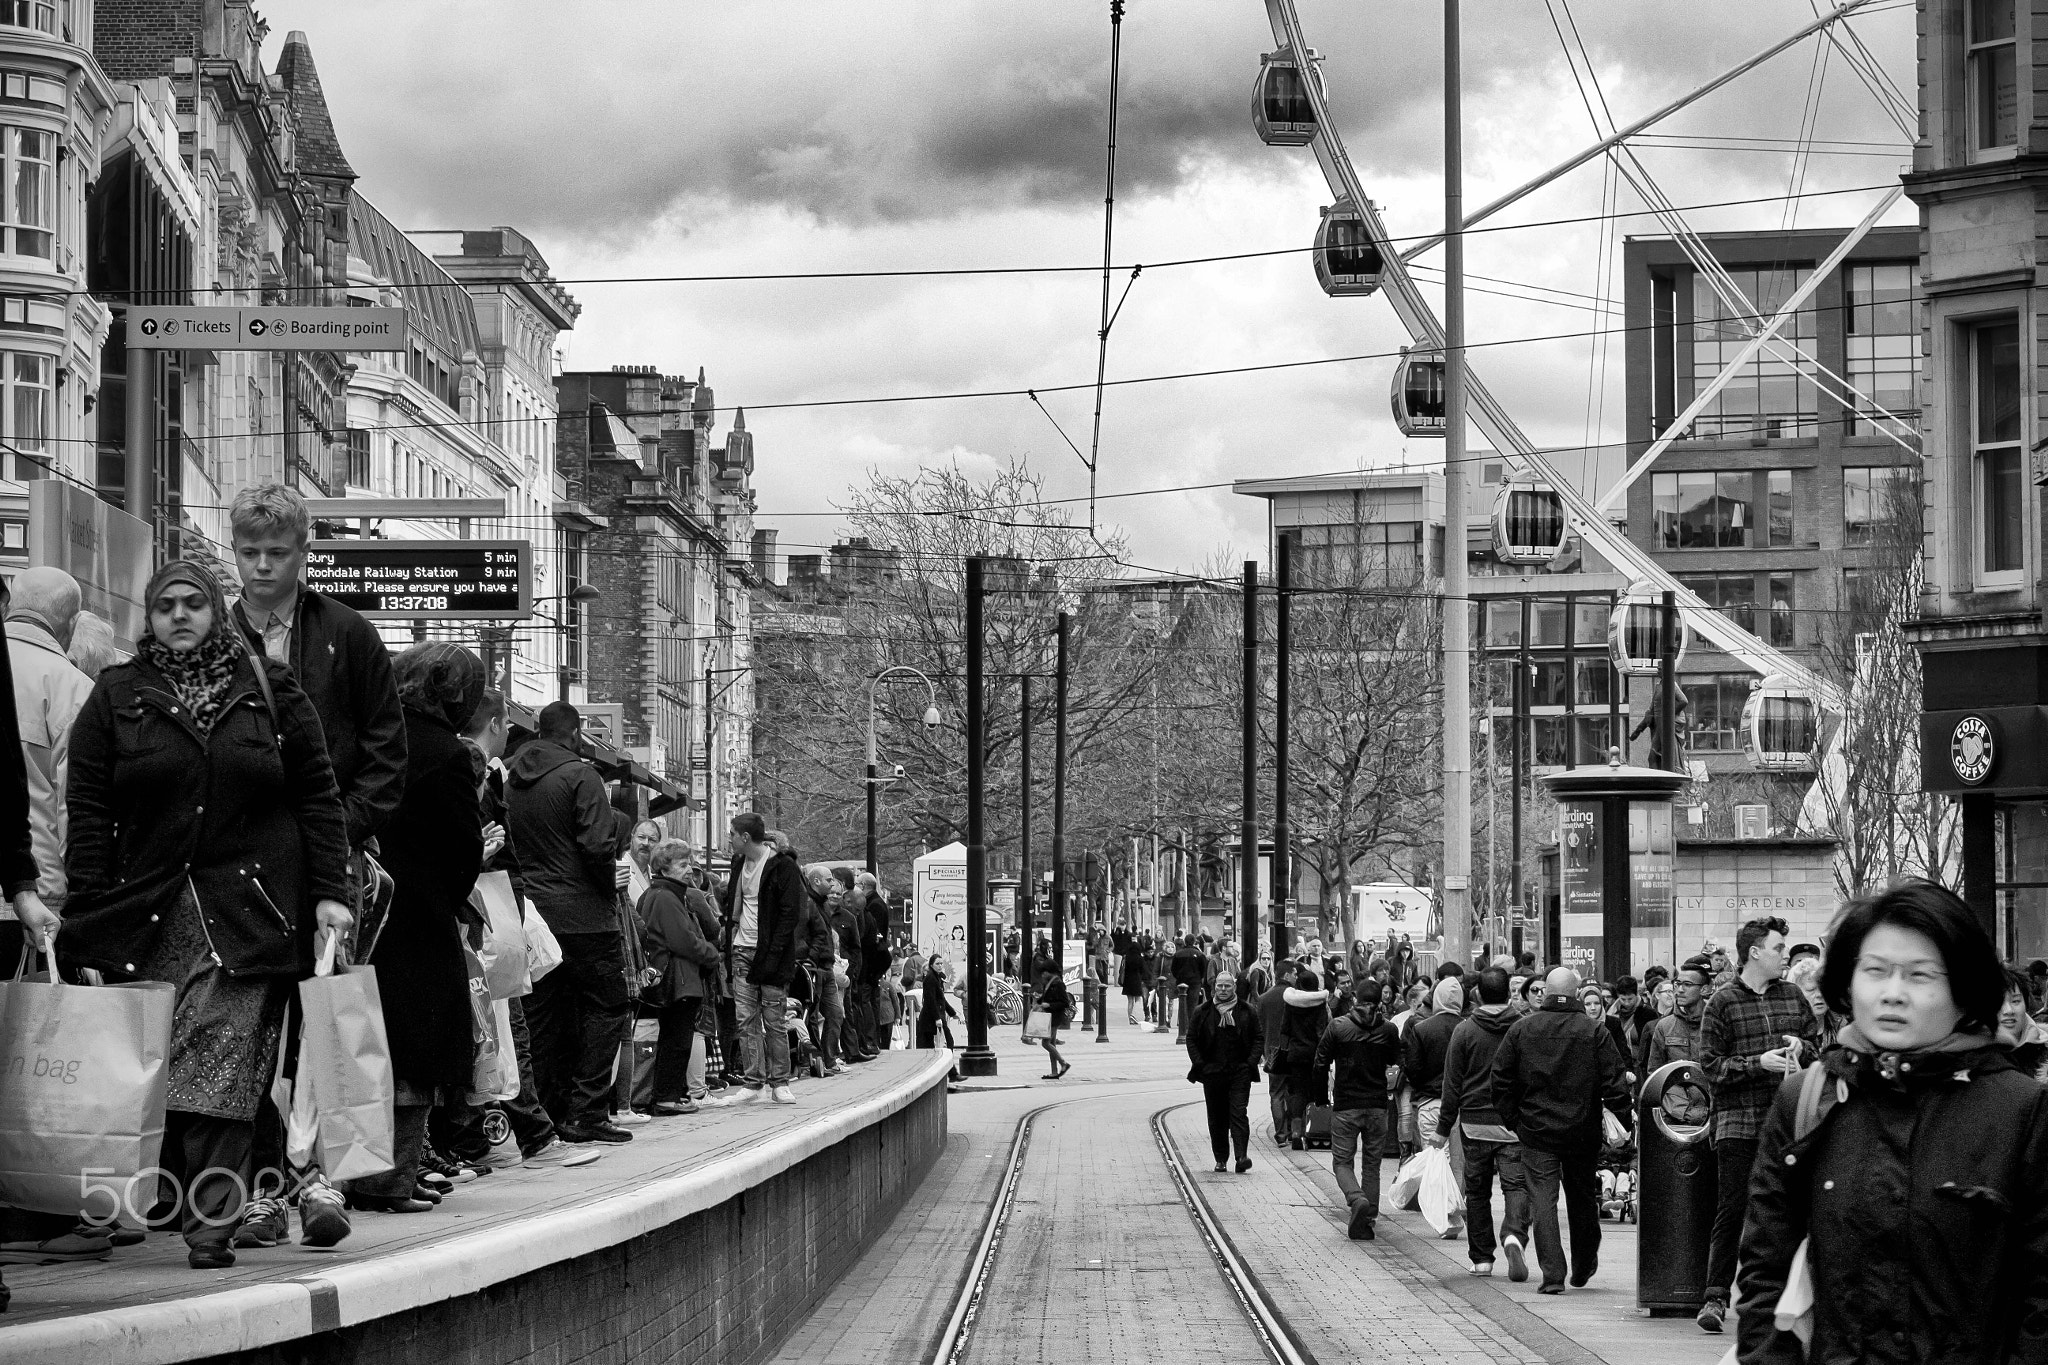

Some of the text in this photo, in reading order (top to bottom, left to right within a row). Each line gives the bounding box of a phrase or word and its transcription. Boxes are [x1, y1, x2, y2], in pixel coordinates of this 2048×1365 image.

[183, 320, 232, 334] Tickets
[291, 320, 390, 338] Boarding point
[307, 551, 517, 566] Bury 5 min
[307, 566, 517, 580] Rochdale Railway Station 9 min
[364, 581, 405, 593] Please
[408, 583, 450, 593] ensure
[453, 583, 475, 595] you
[478, 581, 507, 593] have
[380, 596, 448, 610] 13:37:08
[1956, 719, 1987, 739] COSTA
[1954, 754, 1990, 778] COFFEE
[1562, 809, 1595, 826] arding
[933, 868, 966, 876] SPECIALIST
[1575, 890, 1601, 898] Santander
[1677, 897, 1807, 909] LLY GARDENS
[1561, 945, 1595, 961] arding
[1062, 966, 1081, 983] eet
[33, 1053, 82, 1085] bag
